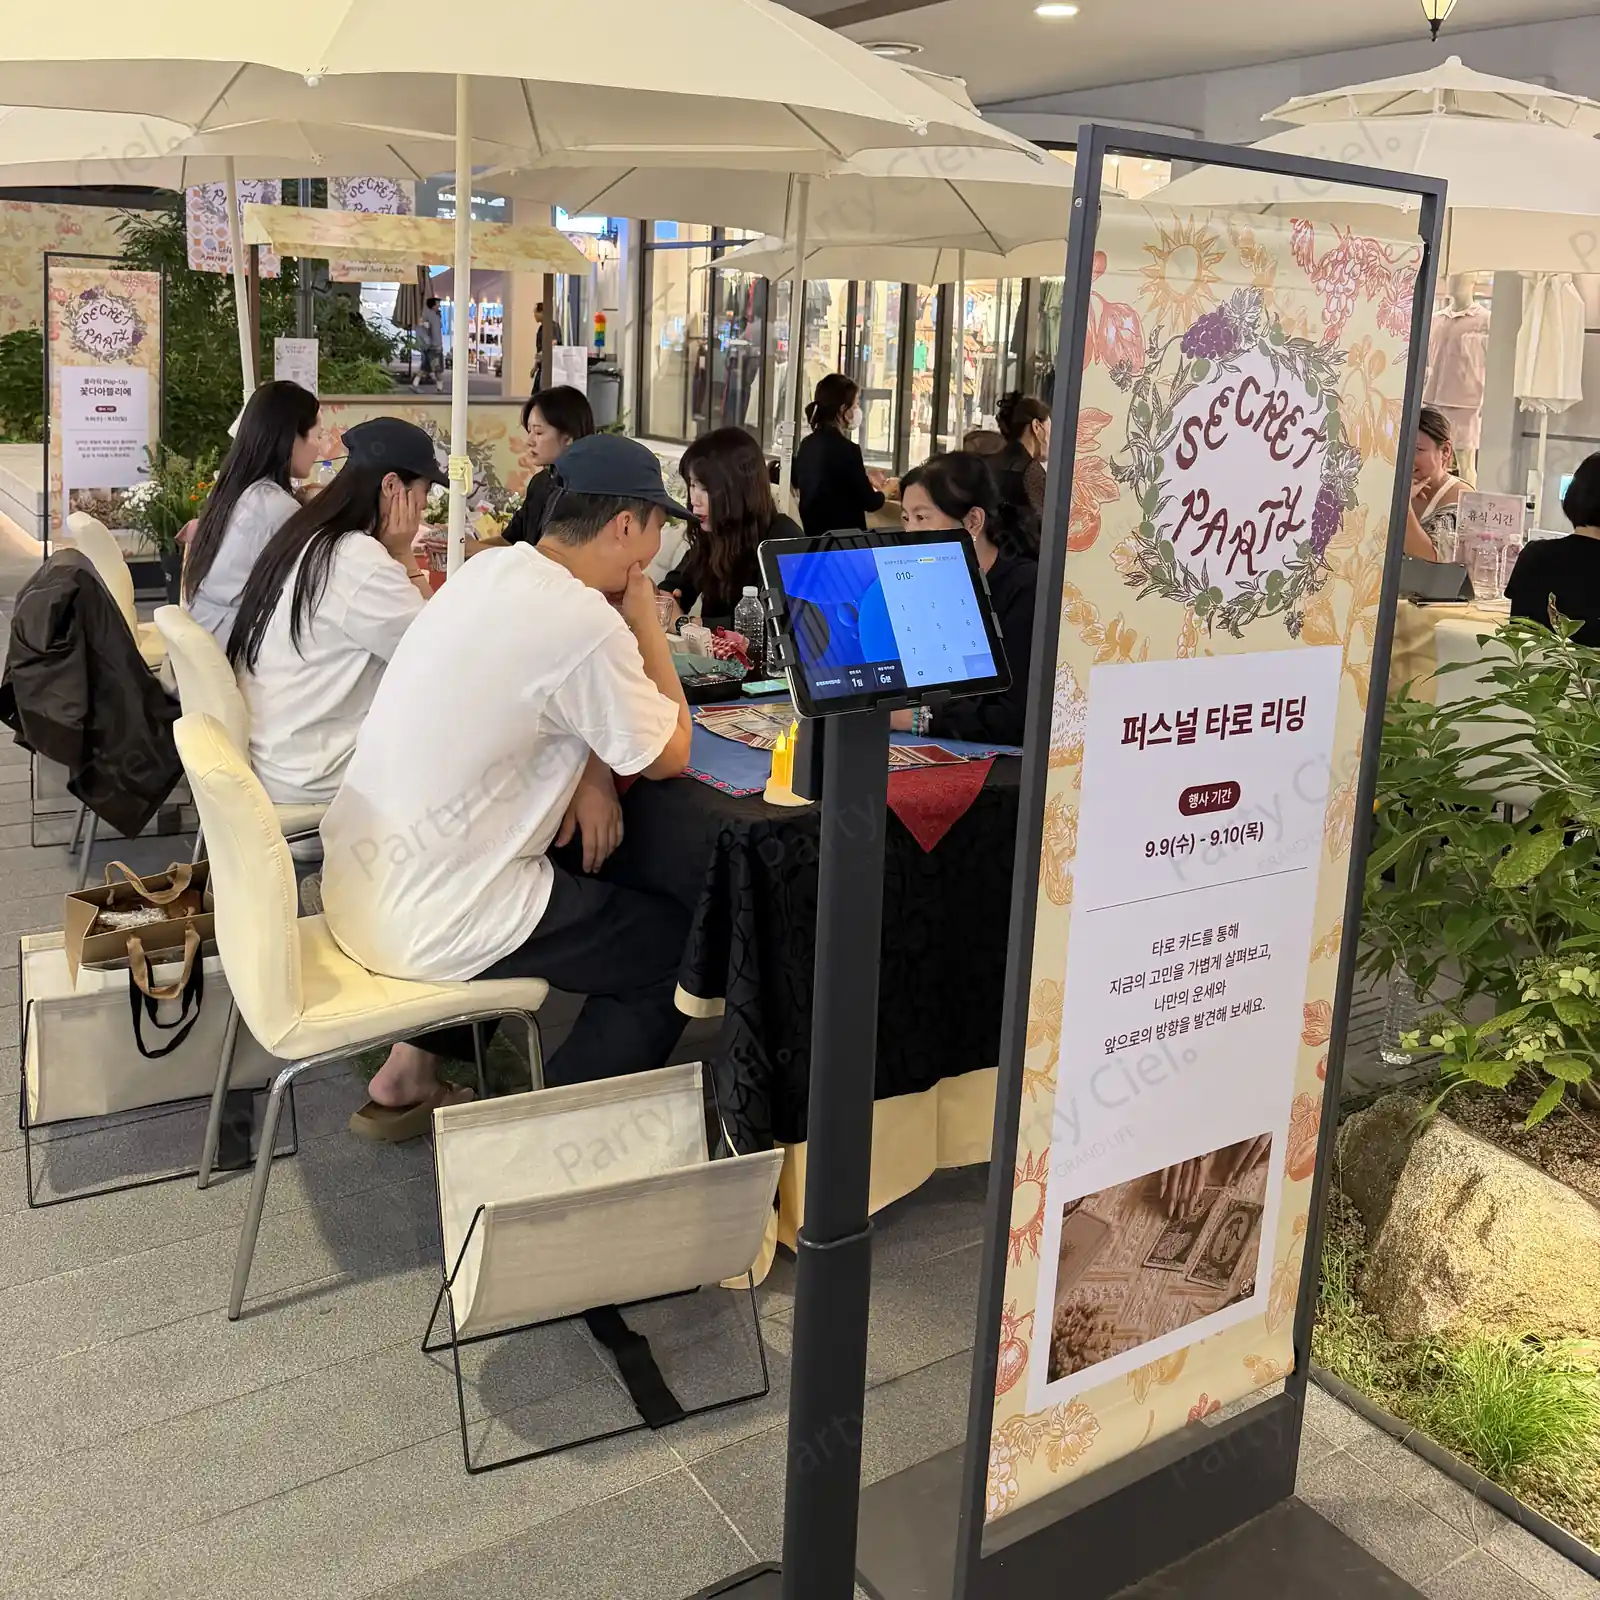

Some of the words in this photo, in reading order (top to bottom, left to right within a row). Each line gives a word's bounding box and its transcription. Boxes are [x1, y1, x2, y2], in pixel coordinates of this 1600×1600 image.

[350, 178, 395, 200] SECRET
[81, 303, 133, 325] SECRET
[83, 328, 129, 349] PARTY
[1176, 376, 1326, 470] SECRET
[1172, 485, 1306, 576] PARTY
[1492, 512, 1513, 527] 시간
[1121, 707, 1199, 750] 퍼스널
[1205, 703, 1253, 740] 타로
[1260, 696, 1307, 734] 리딩
[1188, 791, 1209, 809] 행사
[1210, 787, 1233, 805] 기간
[1145, 833, 1196, 858] 9.9(수)
[1210, 821, 1264, 846] 9.10(목)
[1151, 938, 1175, 957] 타로
[1178, 929, 1213, 952] 카드를
[1216, 922, 1240, 941] 통해
[1109, 972, 1146, 996] 지금의
[1149, 962, 1185, 986] 고민을
[1187, 953, 1222, 976] 가볍게
[1224, 943, 1272, 966] 살펴보고,
[1153, 990, 1189, 1013] 나만의
[1192, 979, 1227, 1003] 운세와
[1104, 1026, 1153, 1055] 앞으로의
[1156, 1016, 1191, 1041] 방향을
[1193, 1006, 1227, 1030] 발견해
[1230, 997, 1266, 1020] 보세요.
